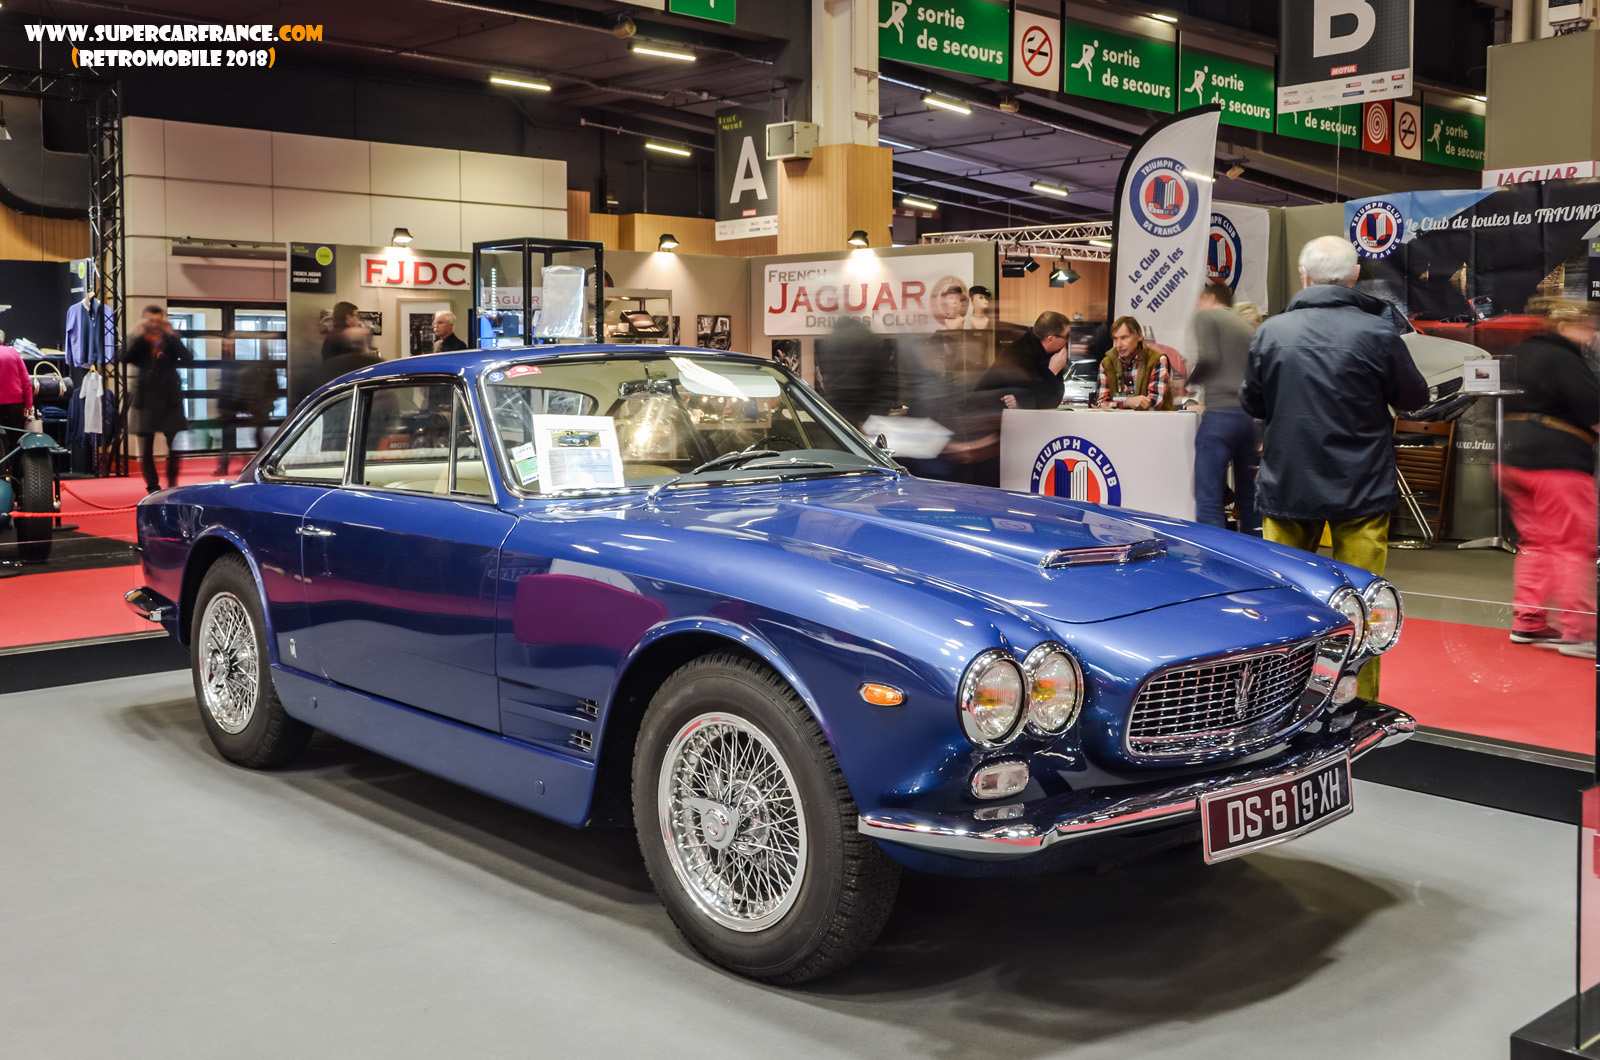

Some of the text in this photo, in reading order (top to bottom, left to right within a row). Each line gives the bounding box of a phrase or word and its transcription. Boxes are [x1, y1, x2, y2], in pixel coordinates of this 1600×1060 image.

[917, 7, 965, 30] sortie
[916, 28, 1003, 64] de secours
[1102, 49, 1140, 68] sortie
[1331, 65, 1356, 75] MOTUL
[1102, 68, 1171, 99] de secours
[1211, 74, 1244, 91] sortie
[1229, 100, 1270, 119] secours
[1305, 112, 1356, 136] de secours
[1445, 125, 1468, 139] sortie
[1445, 141, 1455, 155] de
[729, 136, 768, 204] A
[1141, 160, 1174, 176] TRIUMPH
[1352, 202, 1402, 226] TRIUMPH CLUB
[1406, 219, 1418, 232] Le
[1420, 216, 1449, 231] Club
[1452, 215, 1468, 229] de
[1471, 213, 1510, 227] toutes
[1512, 211, 1531, 225] les
[1143, 221, 1181, 235] DE FRANCE
[1353, 241, 1362, 252] DE
[1366, 238, 1400, 259] FRANCE
[366, 259, 470, 286] F.J.D.C.
[768, 269, 827, 283] FRENCH
[1128, 248, 1160, 284] Le Club
[1130, 247, 1184, 309] de Toutes les
[485, 296, 540, 304] JAGUR
[768, 281, 927, 314] JAGUAR
[1146, 266, 1189, 313] TRIUMPH
[882, 313, 929, 326] CLUB
[1032, 438, 1117, 487] TRIUMPH CLUB
